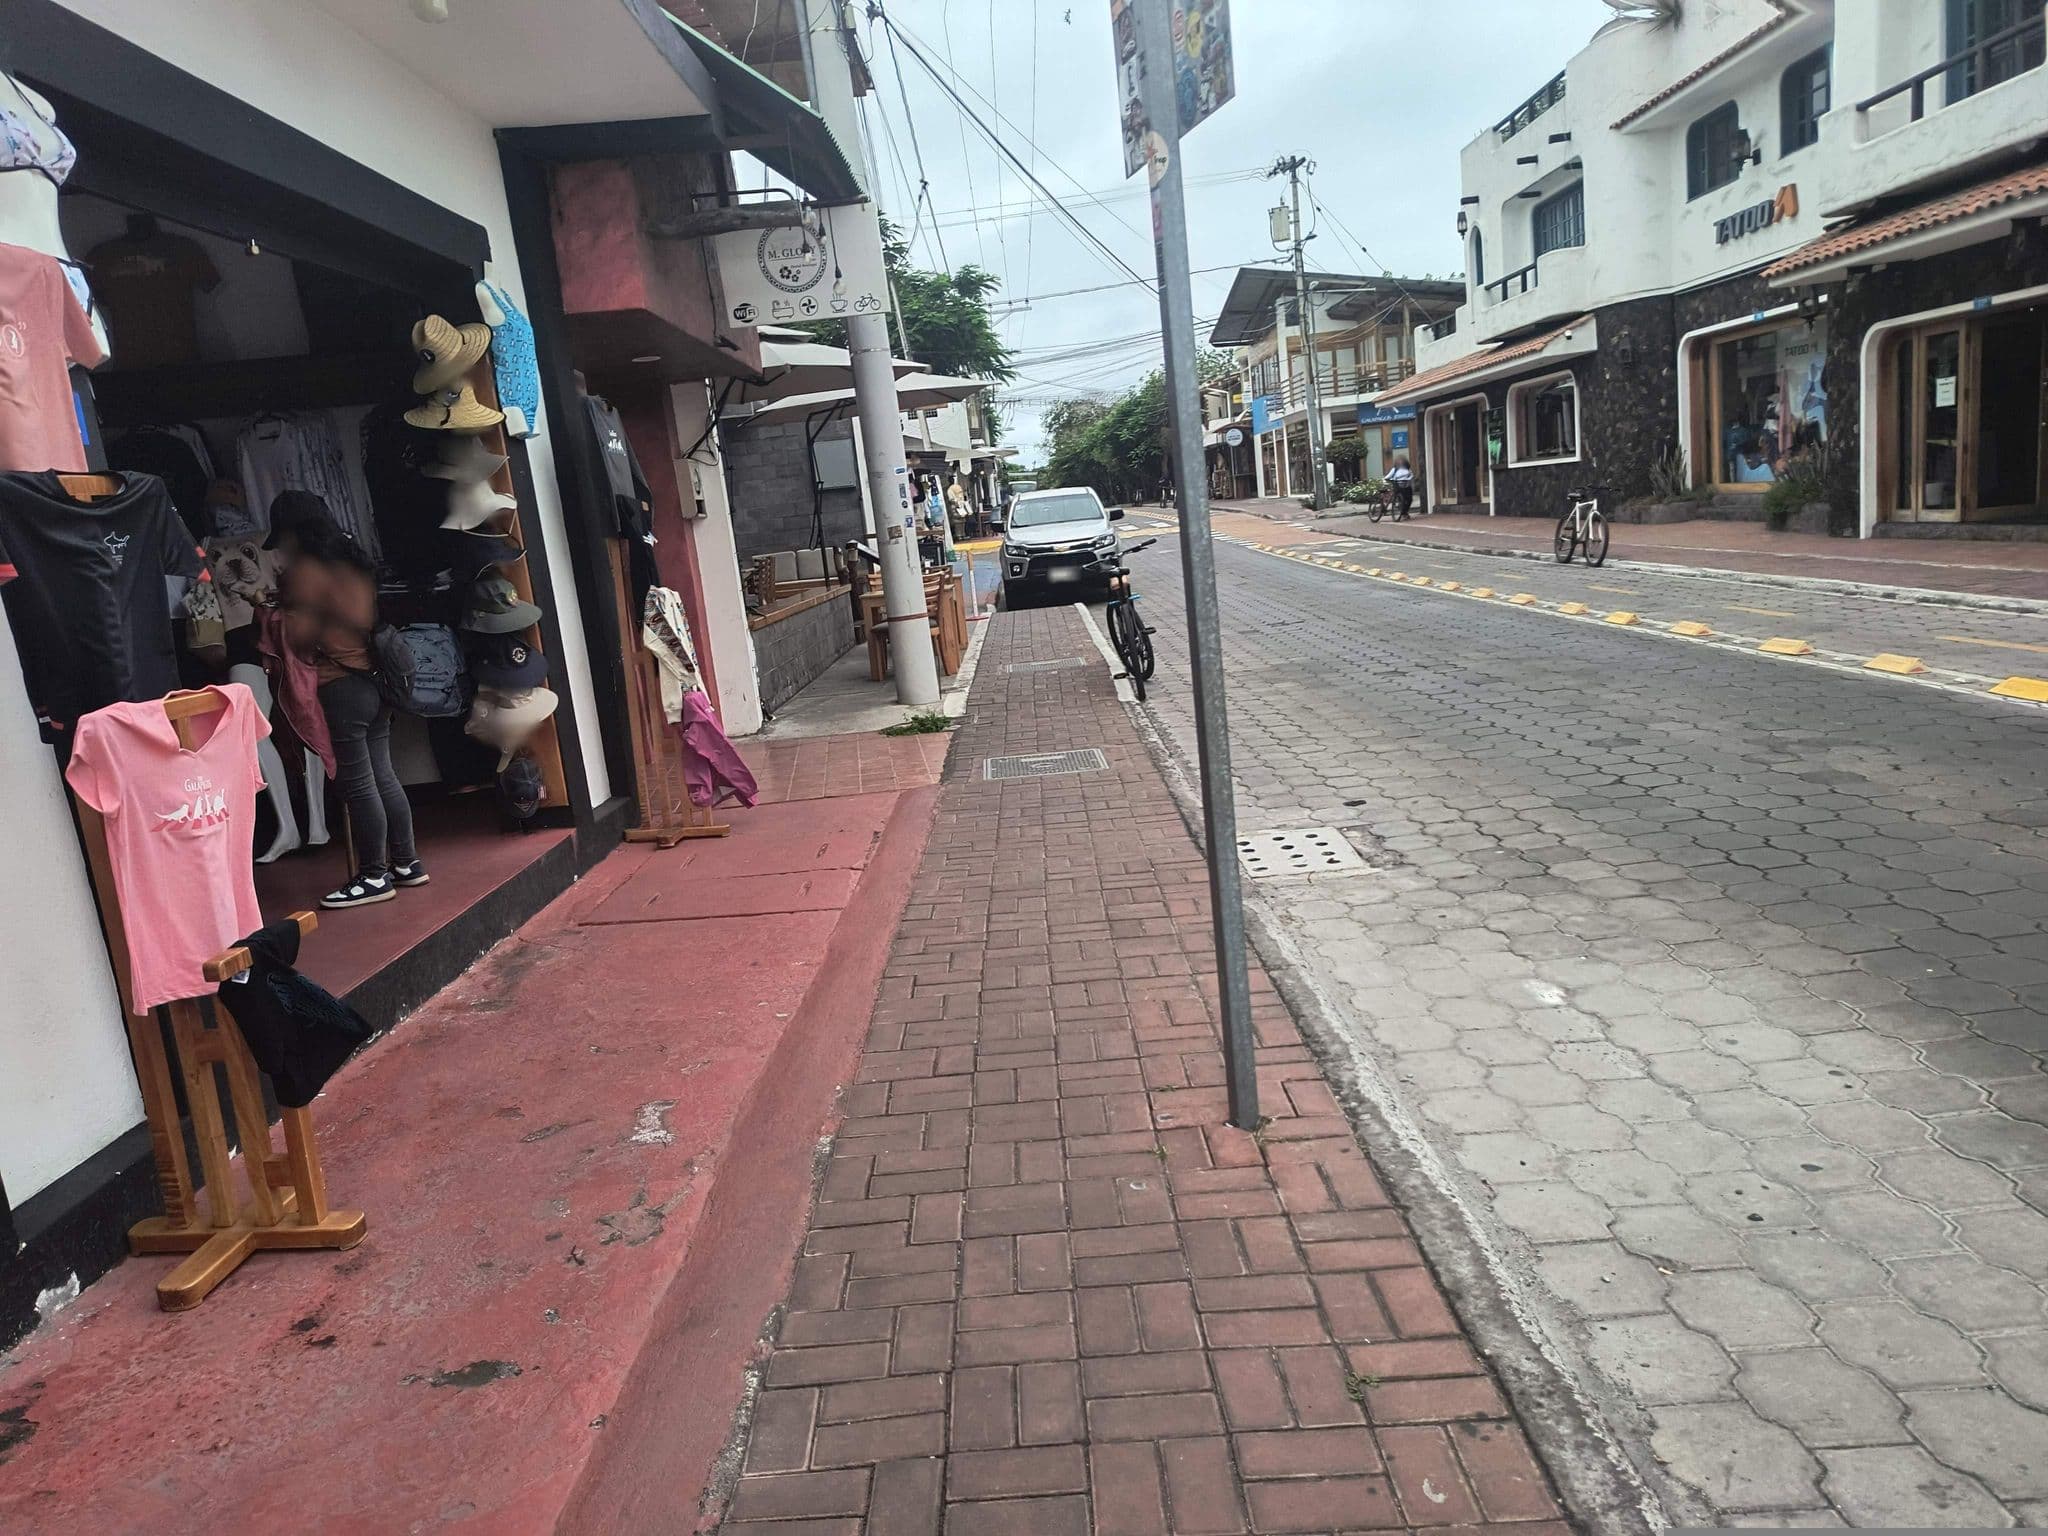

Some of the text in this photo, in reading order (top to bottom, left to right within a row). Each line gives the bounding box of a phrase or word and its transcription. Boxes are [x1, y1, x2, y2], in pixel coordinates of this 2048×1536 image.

[1713, 199, 1776, 244] TATOO
[768, 245, 816, 260] M. GLOY
